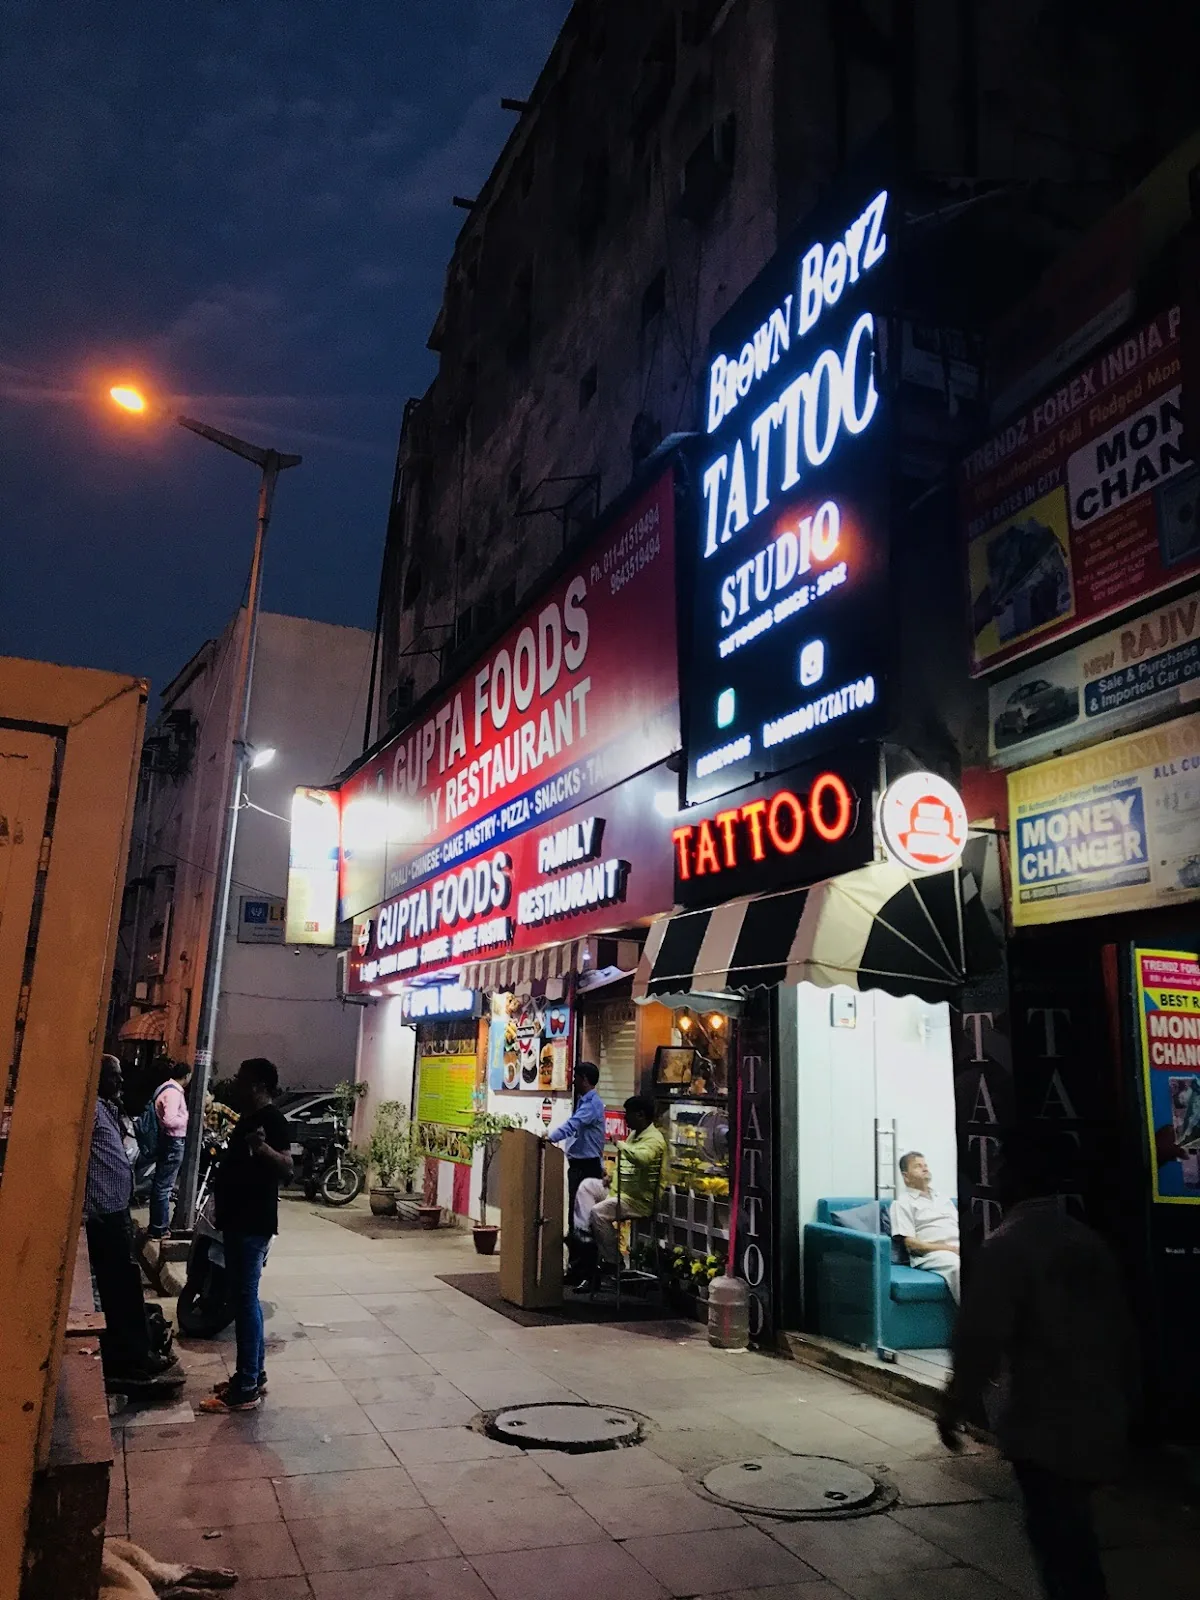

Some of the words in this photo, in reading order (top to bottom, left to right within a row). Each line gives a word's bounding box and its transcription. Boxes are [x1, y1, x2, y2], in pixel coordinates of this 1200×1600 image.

[963, 416, 1028, 480] TRENDZ
[1033, 366, 1097, 434] FOREX
[1101, 322, 1163, 387] INDIA
[721, 501, 839, 628] STUDIO
[1121, 600, 1198, 663] RAJIV
[392, 692, 467, 798] GUPTA
[474, 575, 589, 748] FOODS
[1090, 698, 1099, 712] &
[1101, 675, 1155, 708] Imported
[1157, 668, 1181, 686] Car
[1098, 673, 1124, 693] Sale
[1126, 667, 1137, 683] &
[1138, 645, 1198, 678] Purchase
[445, 676, 592, 825] RESTAURANT
[1154, 763, 1178, 779] ALL
[411, 847, 441, 880] CHINESE
[442, 836, 465, 864] CAKE
[465, 814, 498, 852] PASTRY
[500, 798, 531, 832] PIZZA
[534, 767, 582, 815] SNACKS
[538, 816, 595, 875] FAMILY
[672, 771, 850, 881] TATTOO
[1021, 793, 1137, 849] MONEY
[1020, 830, 1144, 881] CHANGER
[377, 888, 429, 950] GUPTA
[430, 850, 508, 930] FOODS
[517, 858, 619, 926] RESTAURANT
[1160, 993, 1188, 1008] BEST
